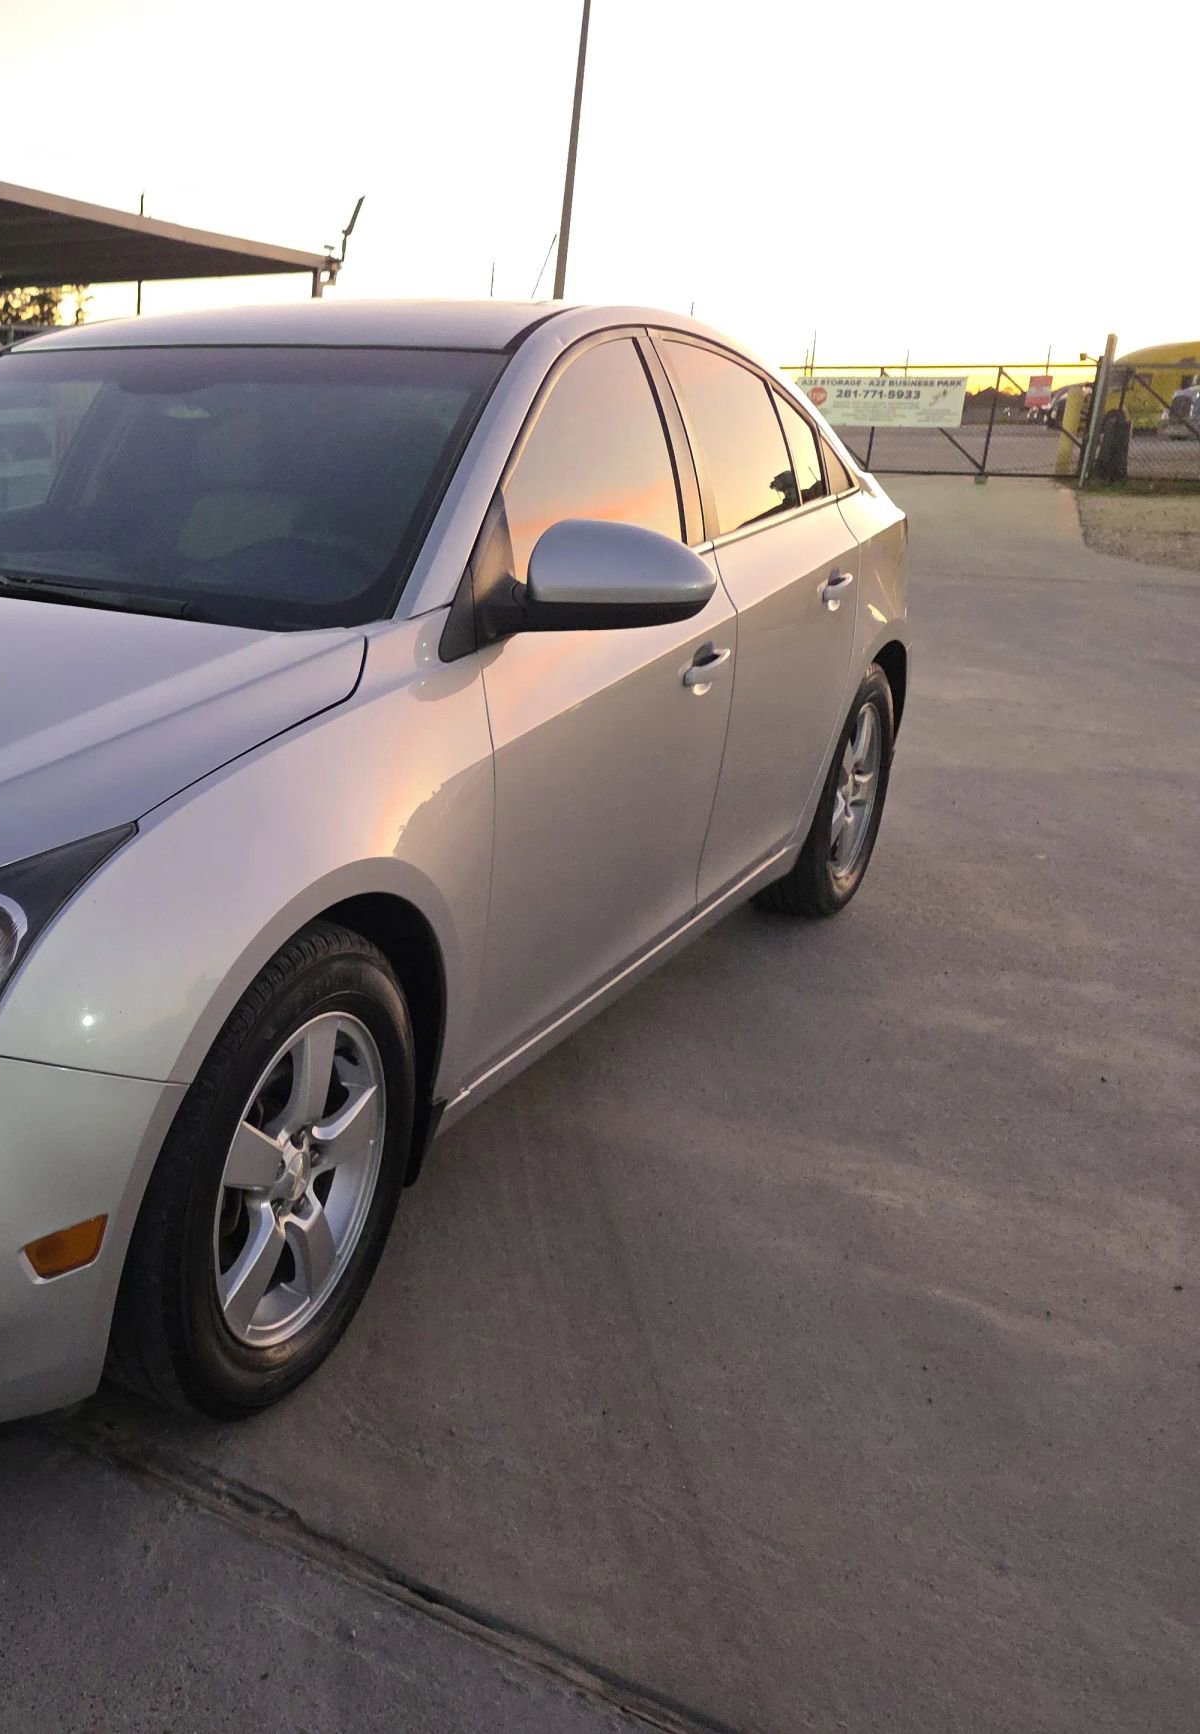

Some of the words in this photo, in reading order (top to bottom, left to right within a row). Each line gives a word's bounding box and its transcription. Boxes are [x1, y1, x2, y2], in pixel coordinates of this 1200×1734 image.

[820, 379, 862, 387] STORAGE
[888, 379, 935, 387] BUSINESS
[936, 379, 963, 388] PARK
